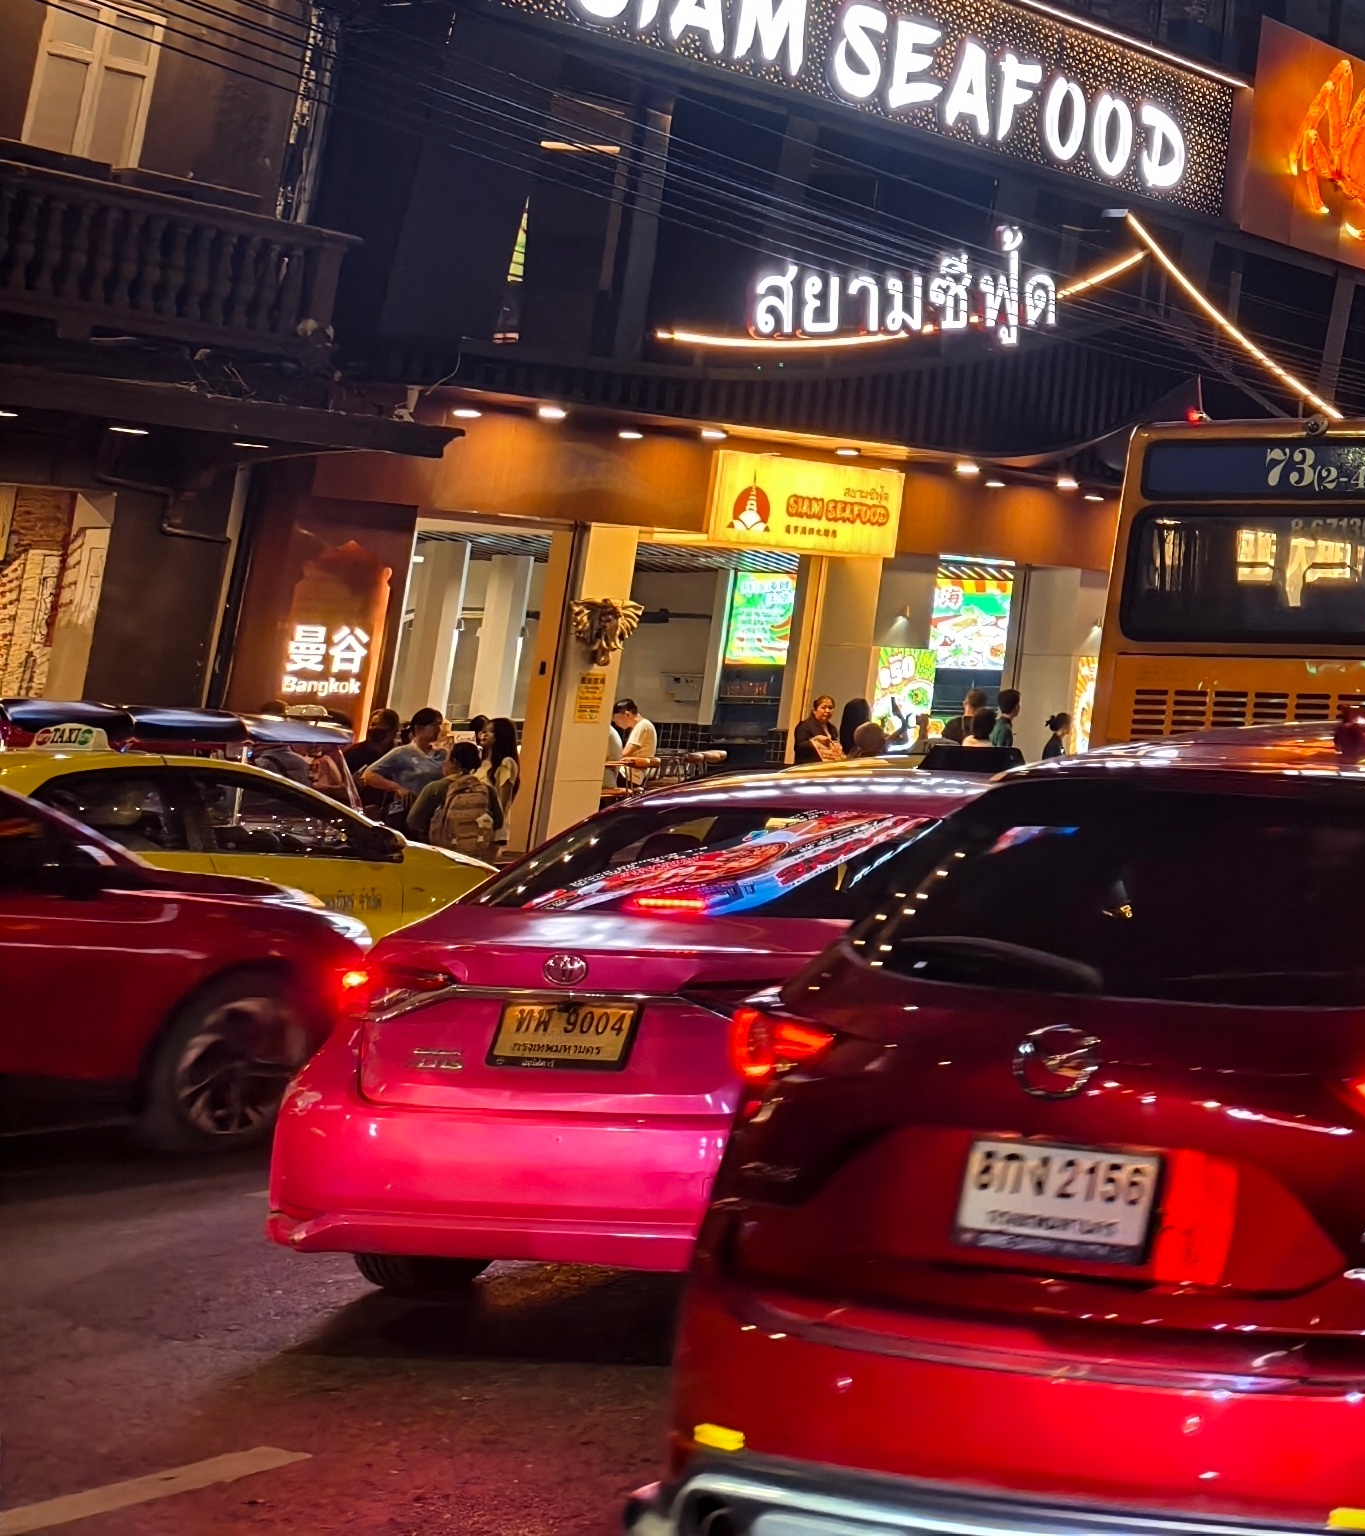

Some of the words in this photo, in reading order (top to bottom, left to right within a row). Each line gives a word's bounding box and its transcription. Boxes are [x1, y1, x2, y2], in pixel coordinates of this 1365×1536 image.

[831, 4, 1188, 189] SEAFOOD
[754, 225, 1058, 345] สยามซีฟู้ด
[786, 493, 825, 521] SIAM
[825, 499, 890, 527] SEAFOOD
[285, 624, 370, 674] 曼谷
[281, 674, 361, 697] Bangkok
[50, 727, 83, 744] TAXI
[563, 1009, 629, 1038] 9004
[1055, 1158, 1146, 1206] 2156
